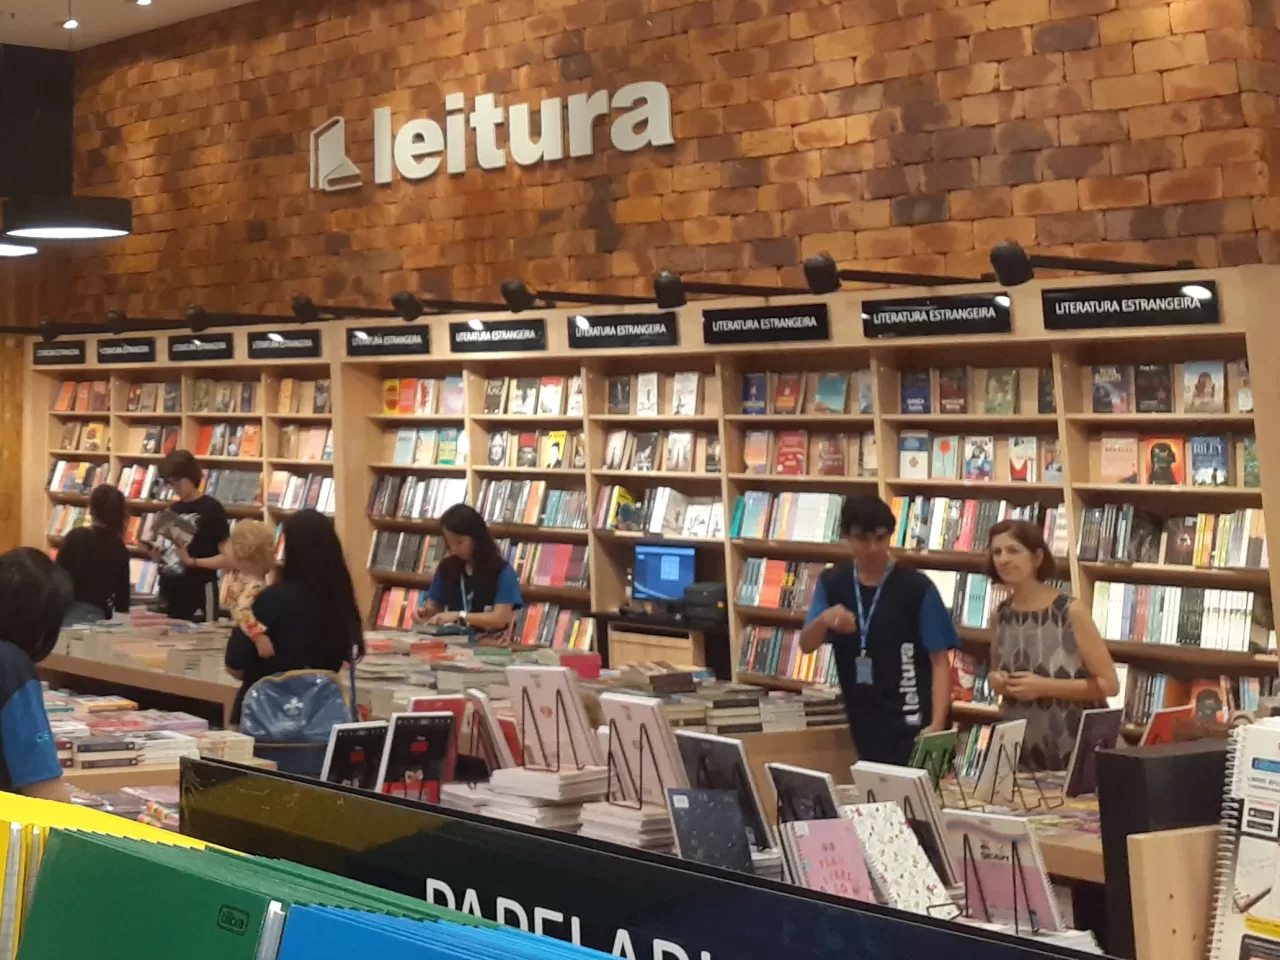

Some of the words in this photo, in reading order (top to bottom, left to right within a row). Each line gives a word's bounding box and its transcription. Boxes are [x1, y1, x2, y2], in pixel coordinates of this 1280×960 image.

[373, 81, 675, 185] leitura
[1055, 299, 1120, 315] LITERATURA
[1122, 297, 1201, 313] ESTRANGEIRA
[712, 319, 760, 332] LITERATURA
[760, 316, 818, 330] ESTRANGEIRA
[873, 310, 928, 325] LITERATURA
[929, 307, 996, 323] ESTRANGEIRA
[455, 330, 490, 343] LITERATURA
[491, 328, 536, 341] ESTRANGEIRA
[575, 324, 616, 338] LITERATURA
[617, 323, 667, 336] ESTRANGEIRA
[899, 642, 920, 712] leitura
